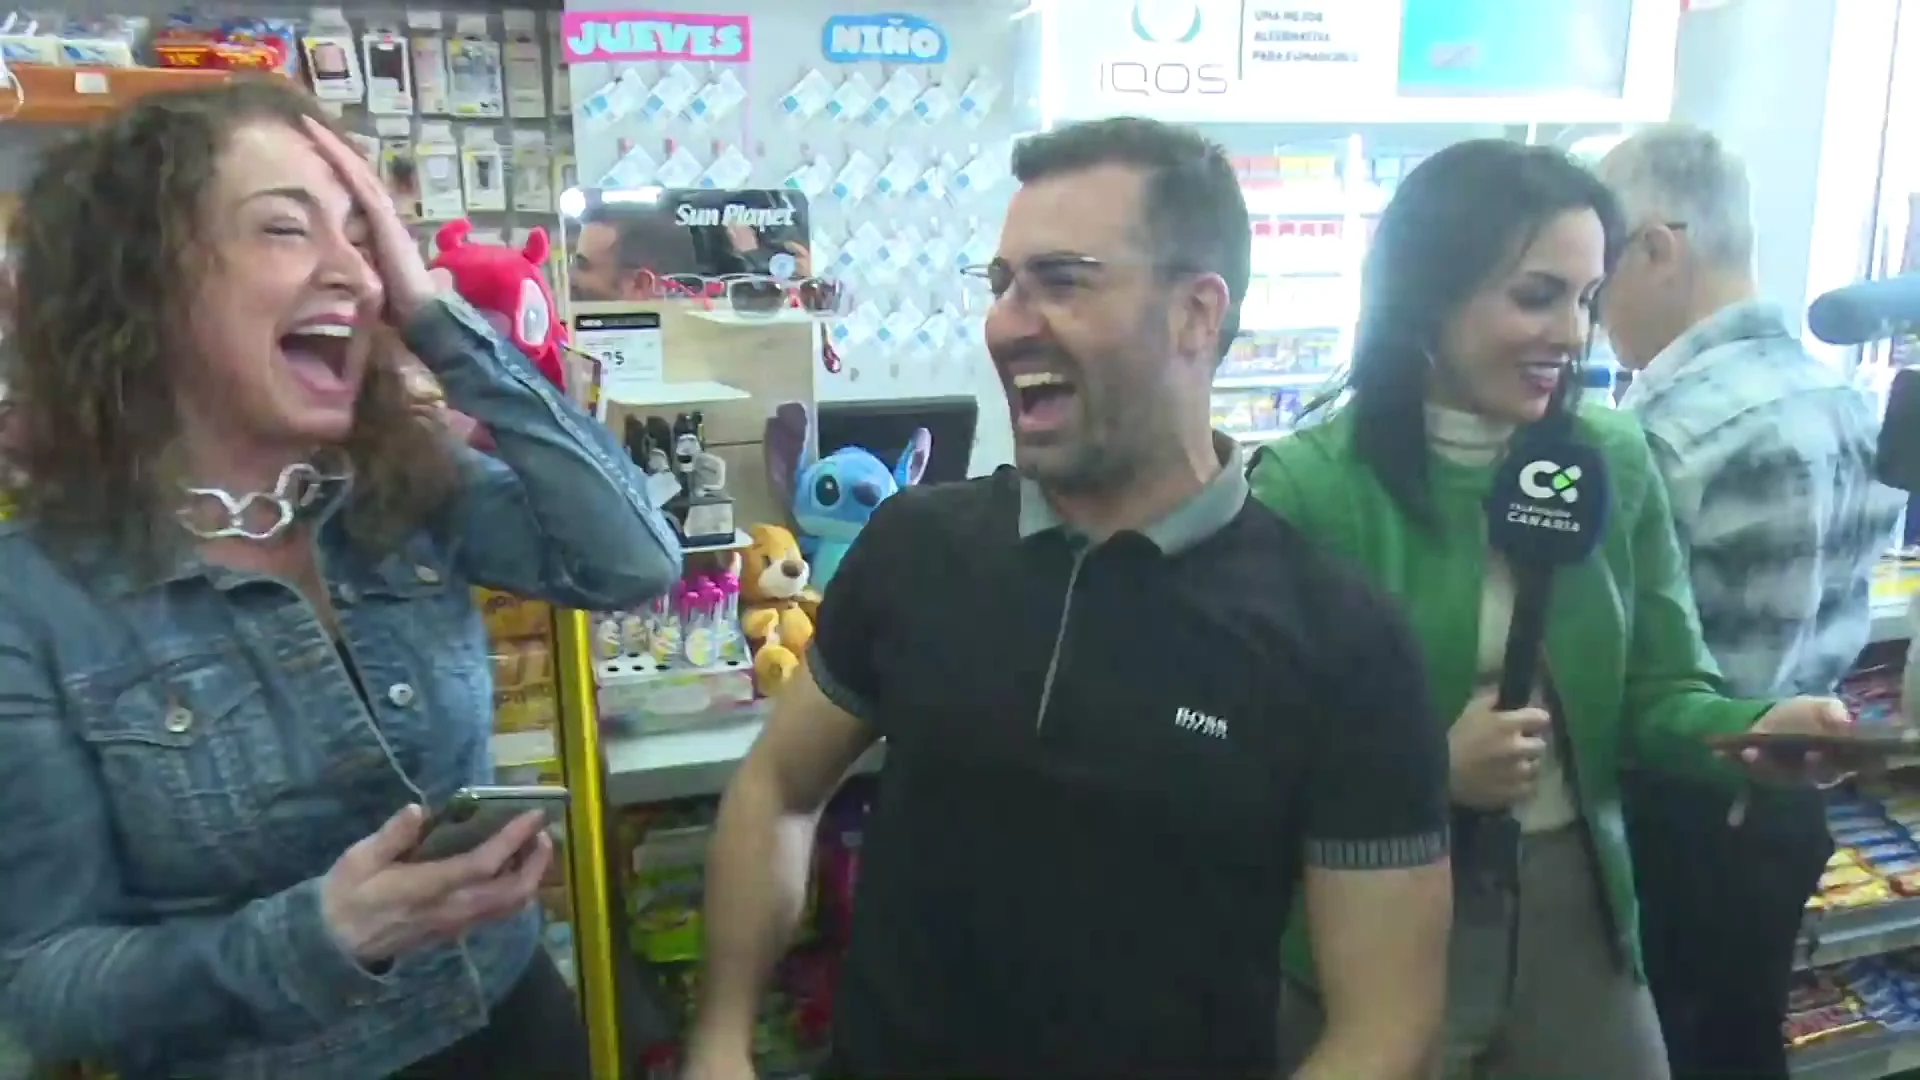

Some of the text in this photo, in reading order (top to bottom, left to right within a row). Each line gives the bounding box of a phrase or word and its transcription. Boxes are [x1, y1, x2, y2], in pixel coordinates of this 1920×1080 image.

[567, 20, 743, 55] JUEVES
[830, 18, 941, 57] NIÑO
[1099, 62, 1228, 96] IQOS
[675, 203, 796, 229] Sun Planet
[1507, 511, 1580, 532] CANARIA
